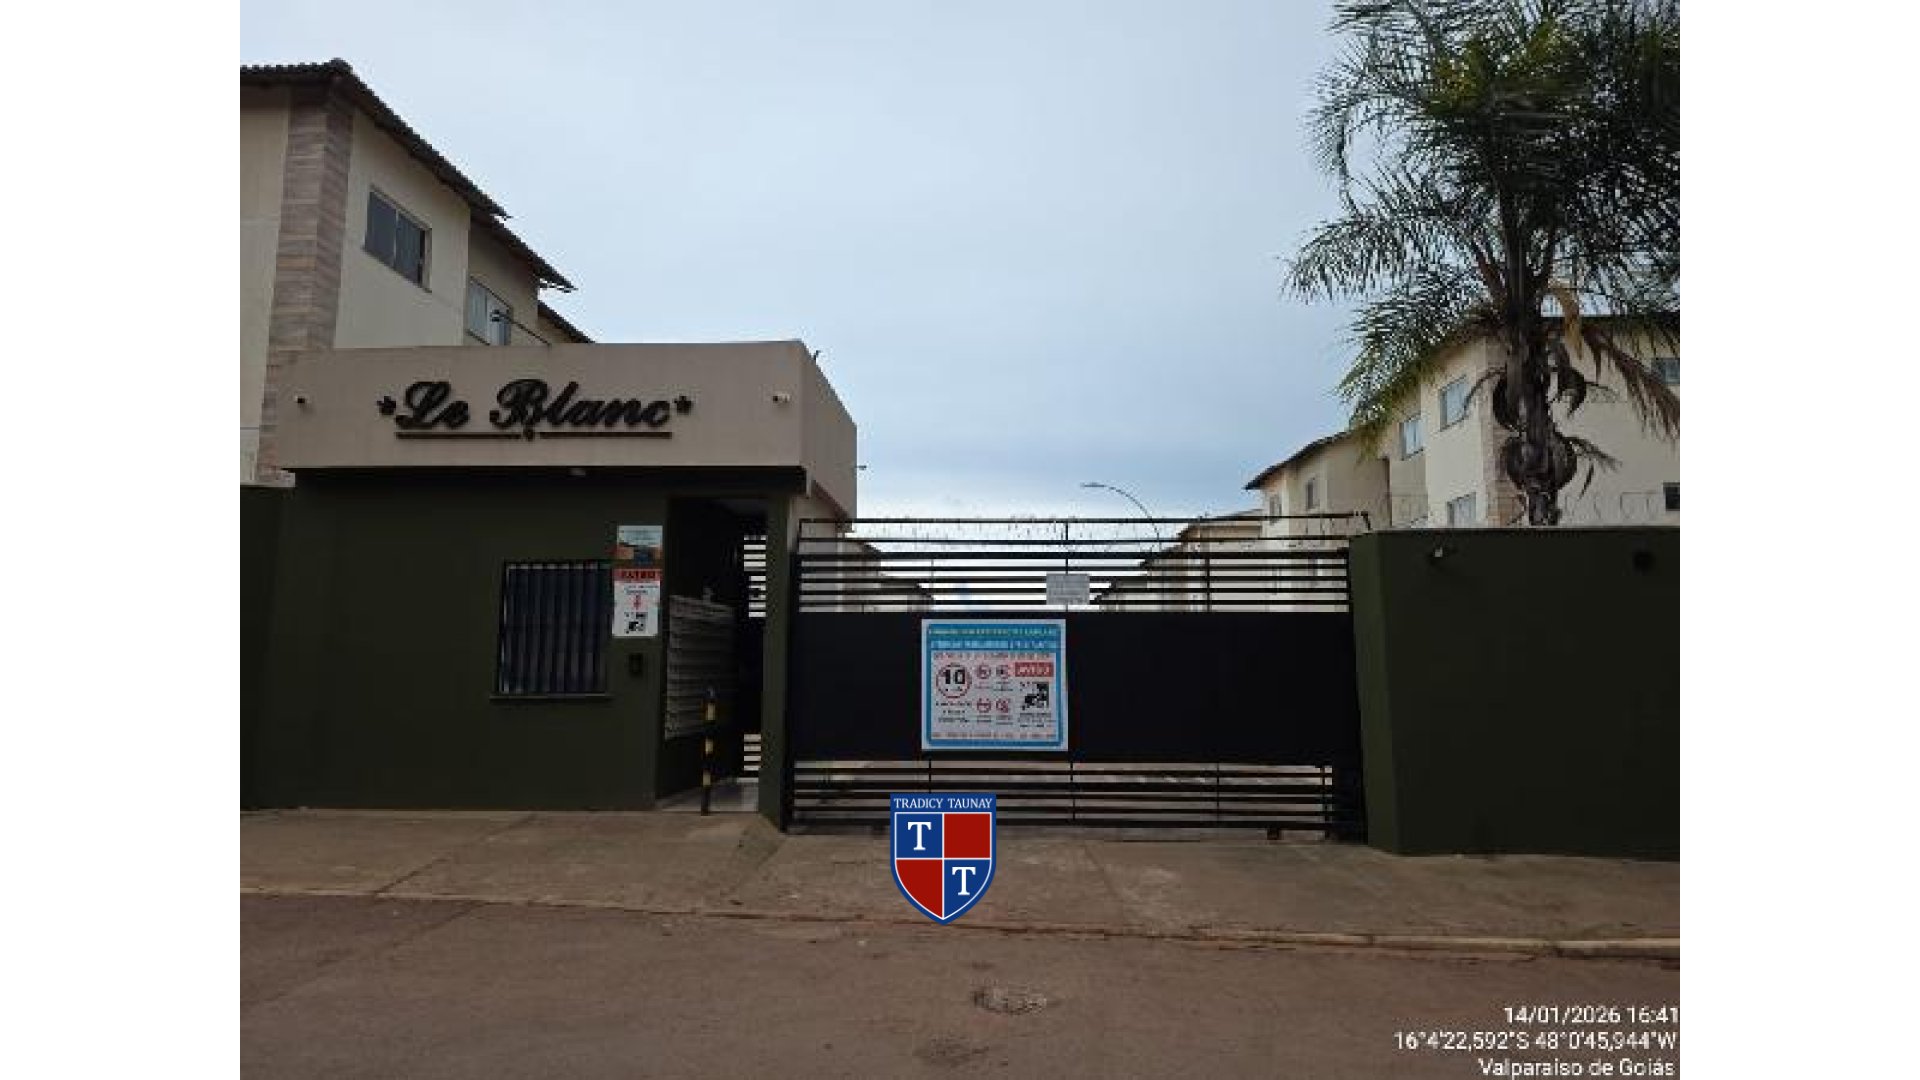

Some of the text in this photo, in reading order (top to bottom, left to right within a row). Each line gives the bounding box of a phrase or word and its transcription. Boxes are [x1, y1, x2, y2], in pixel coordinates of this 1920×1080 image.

[395, 379, 670, 430] Le Blanc
[942, 669, 965, 685] 10
